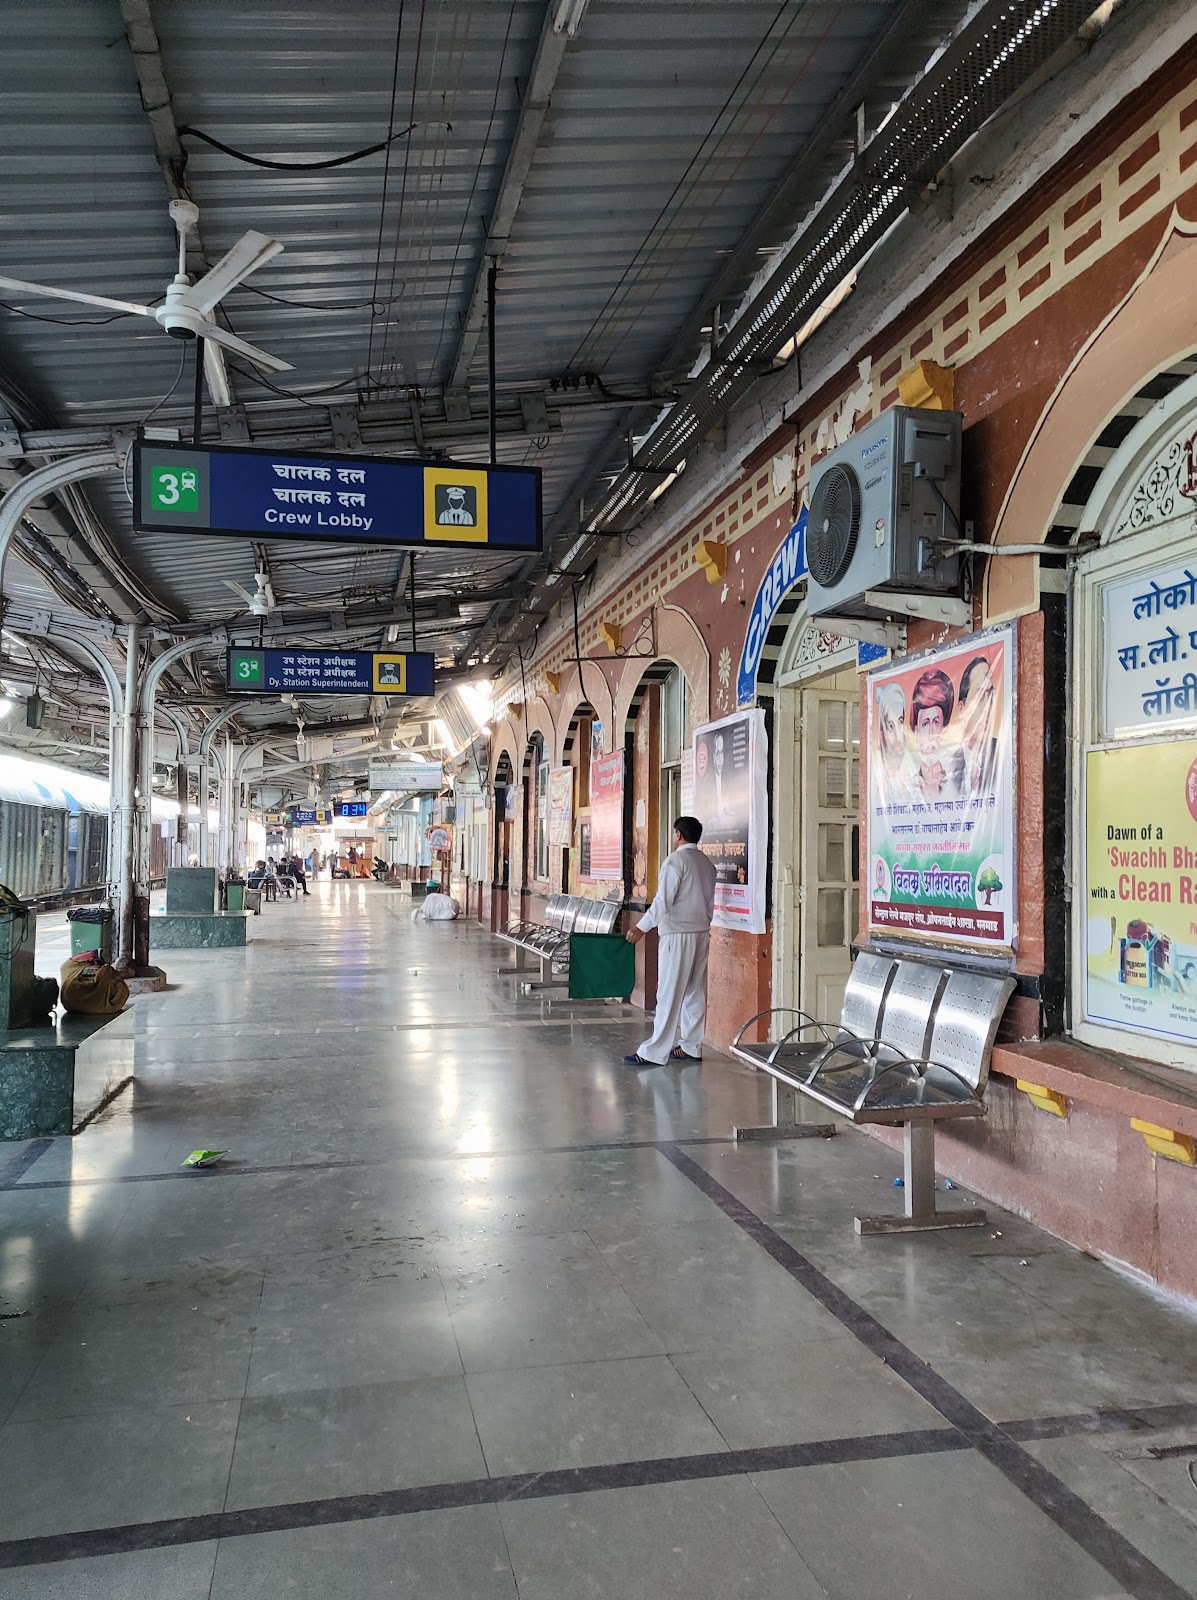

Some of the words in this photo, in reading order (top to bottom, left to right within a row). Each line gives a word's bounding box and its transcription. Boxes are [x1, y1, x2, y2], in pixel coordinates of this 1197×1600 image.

[861, 435, 889, 459] Panasonic
[271, 464, 331, 482] चालक
[335, 468, 366, 485] दल
[158, 473, 180, 504] 3
[271, 488, 331, 506] चालक
[335, 491, 366, 508] दल
[264, 508, 312, 525] Crew
[317, 511, 374, 531] Lobby
[744, 530, 801, 675] CREW
[239, 661, 250, 678] 3
[282, 656, 294, 665] उप
[296, 655, 320, 666] स्टेशन
[323, 656, 357, 667] अधीक्षक
[282, 667, 294, 676] उप
[296, 666, 320, 677] स्टेशन
[323, 667, 357, 678] अधीक्षक
[269, 677, 281, 688] Dy.
[283, 678, 310, 687] Station
[311, 679, 369, 689] Superintendent
[1107, 825, 1137, 841] Dawn
[1140, 824, 1152, 840] of
[1156, 827, 1163, 840] a
[1107, 846, 1167, 868] 'Swachh
[892, 864, 921, 897] विनम्र
[1091, 886, 1108, 899] with
[1110, 889, 1116, 899] a
[1118, 873, 1171, 903] Clean
[1169, 1012, 1178, 1020] and
[1171, 1003, 1187, 1013] Always
